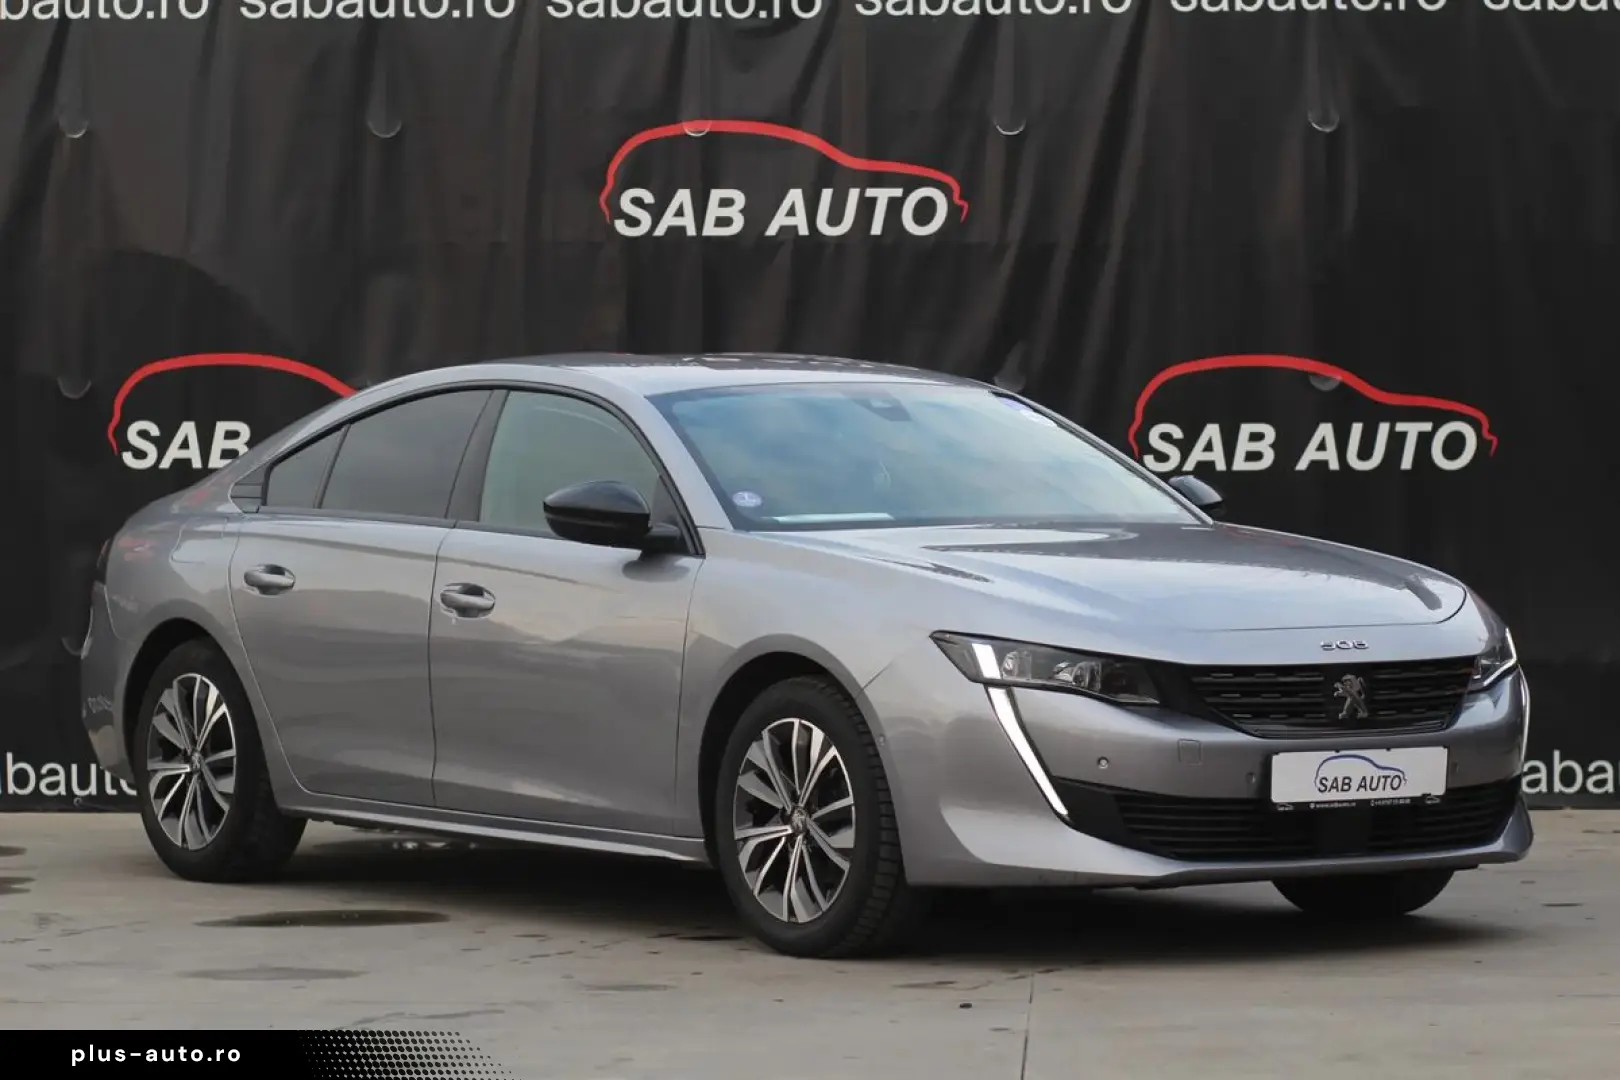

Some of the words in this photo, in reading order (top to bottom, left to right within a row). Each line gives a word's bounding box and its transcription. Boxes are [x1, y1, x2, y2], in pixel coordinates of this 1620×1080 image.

[614, 188, 746, 237] SAB
[765, 186, 949, 237] AUTO
[121, 420, 252, 470] SAB
[1143, 423, 1276, 472] SAB
[1295, 420, 1477, 472] AUTO
[1318, 775, 1352, 793] SAB
[1356, 774, 1402, 792] AUTO
